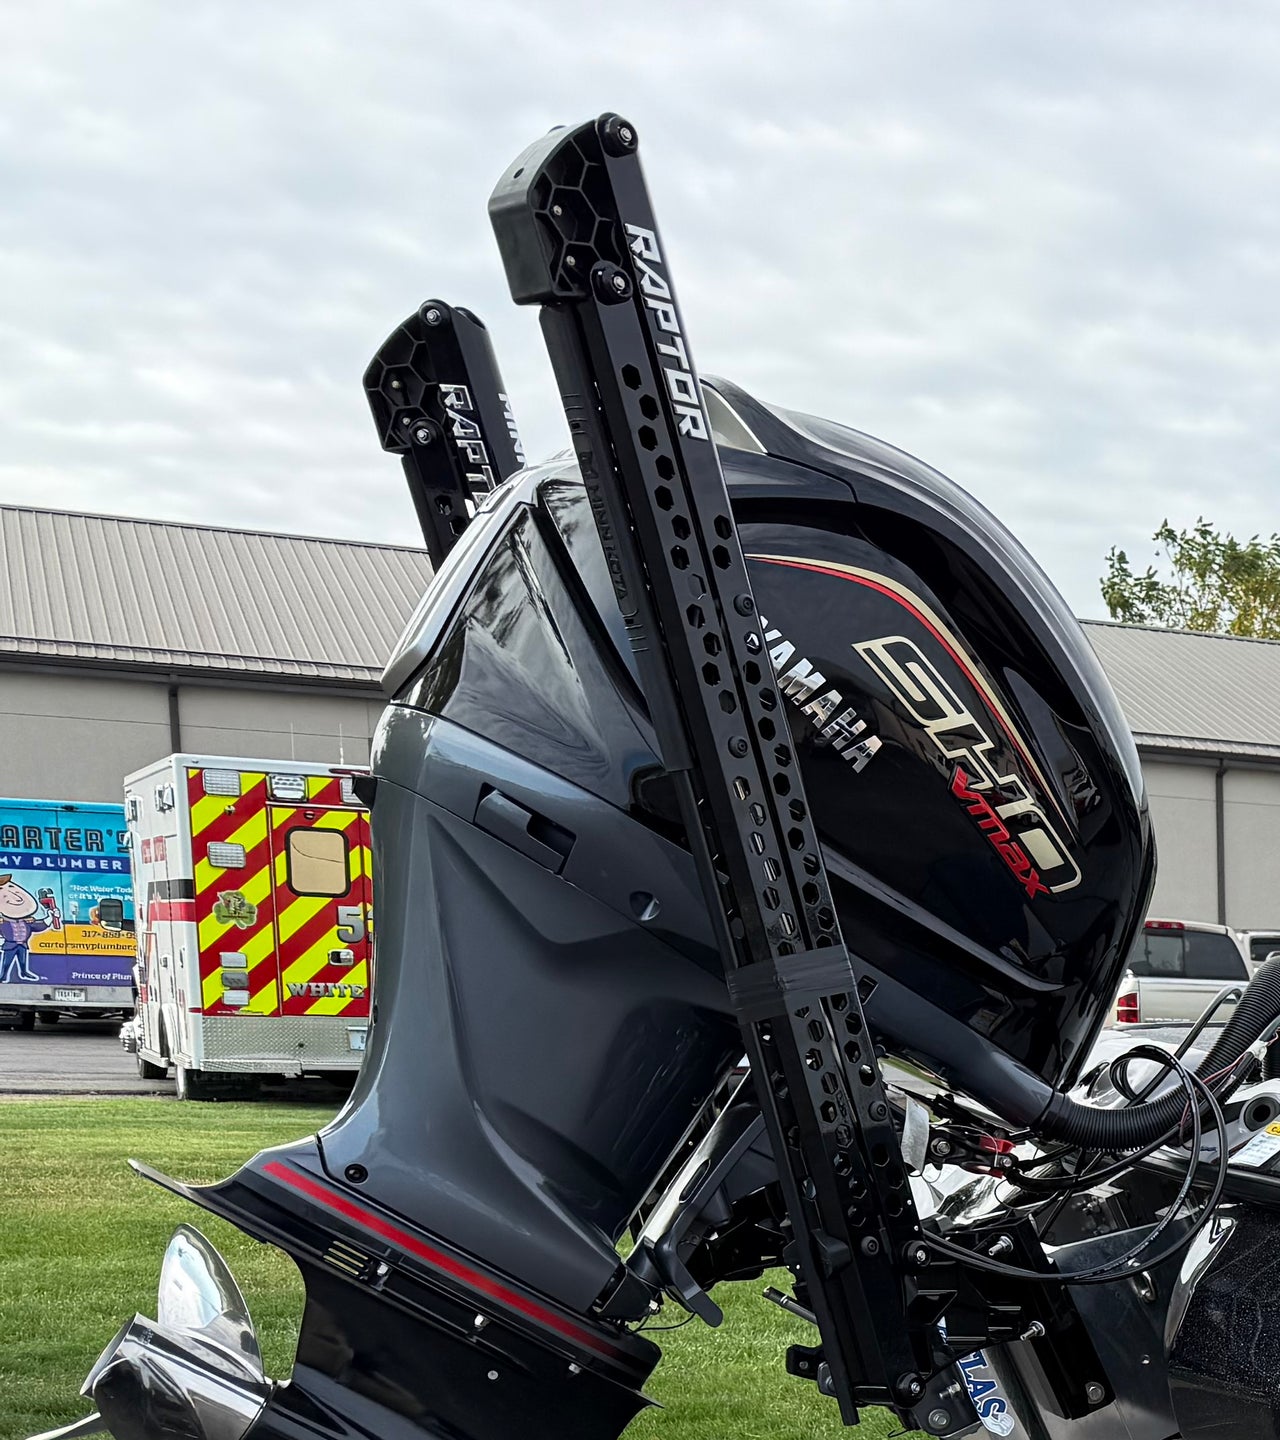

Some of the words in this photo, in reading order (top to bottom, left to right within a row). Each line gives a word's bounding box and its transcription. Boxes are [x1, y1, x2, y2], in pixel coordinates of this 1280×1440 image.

[624, 223, 709, 441] RAPTOR
[439, 384, 497, 519] RAPT
[0, 825, 129, 853] ARTER'S
[33, 857, 122, 870] PLUMBER
[39, 941, 137, 951] cartersmyplumber.c
[72, 972, 101, 980] Prince
[286, 982, 365, 998] WHITE
